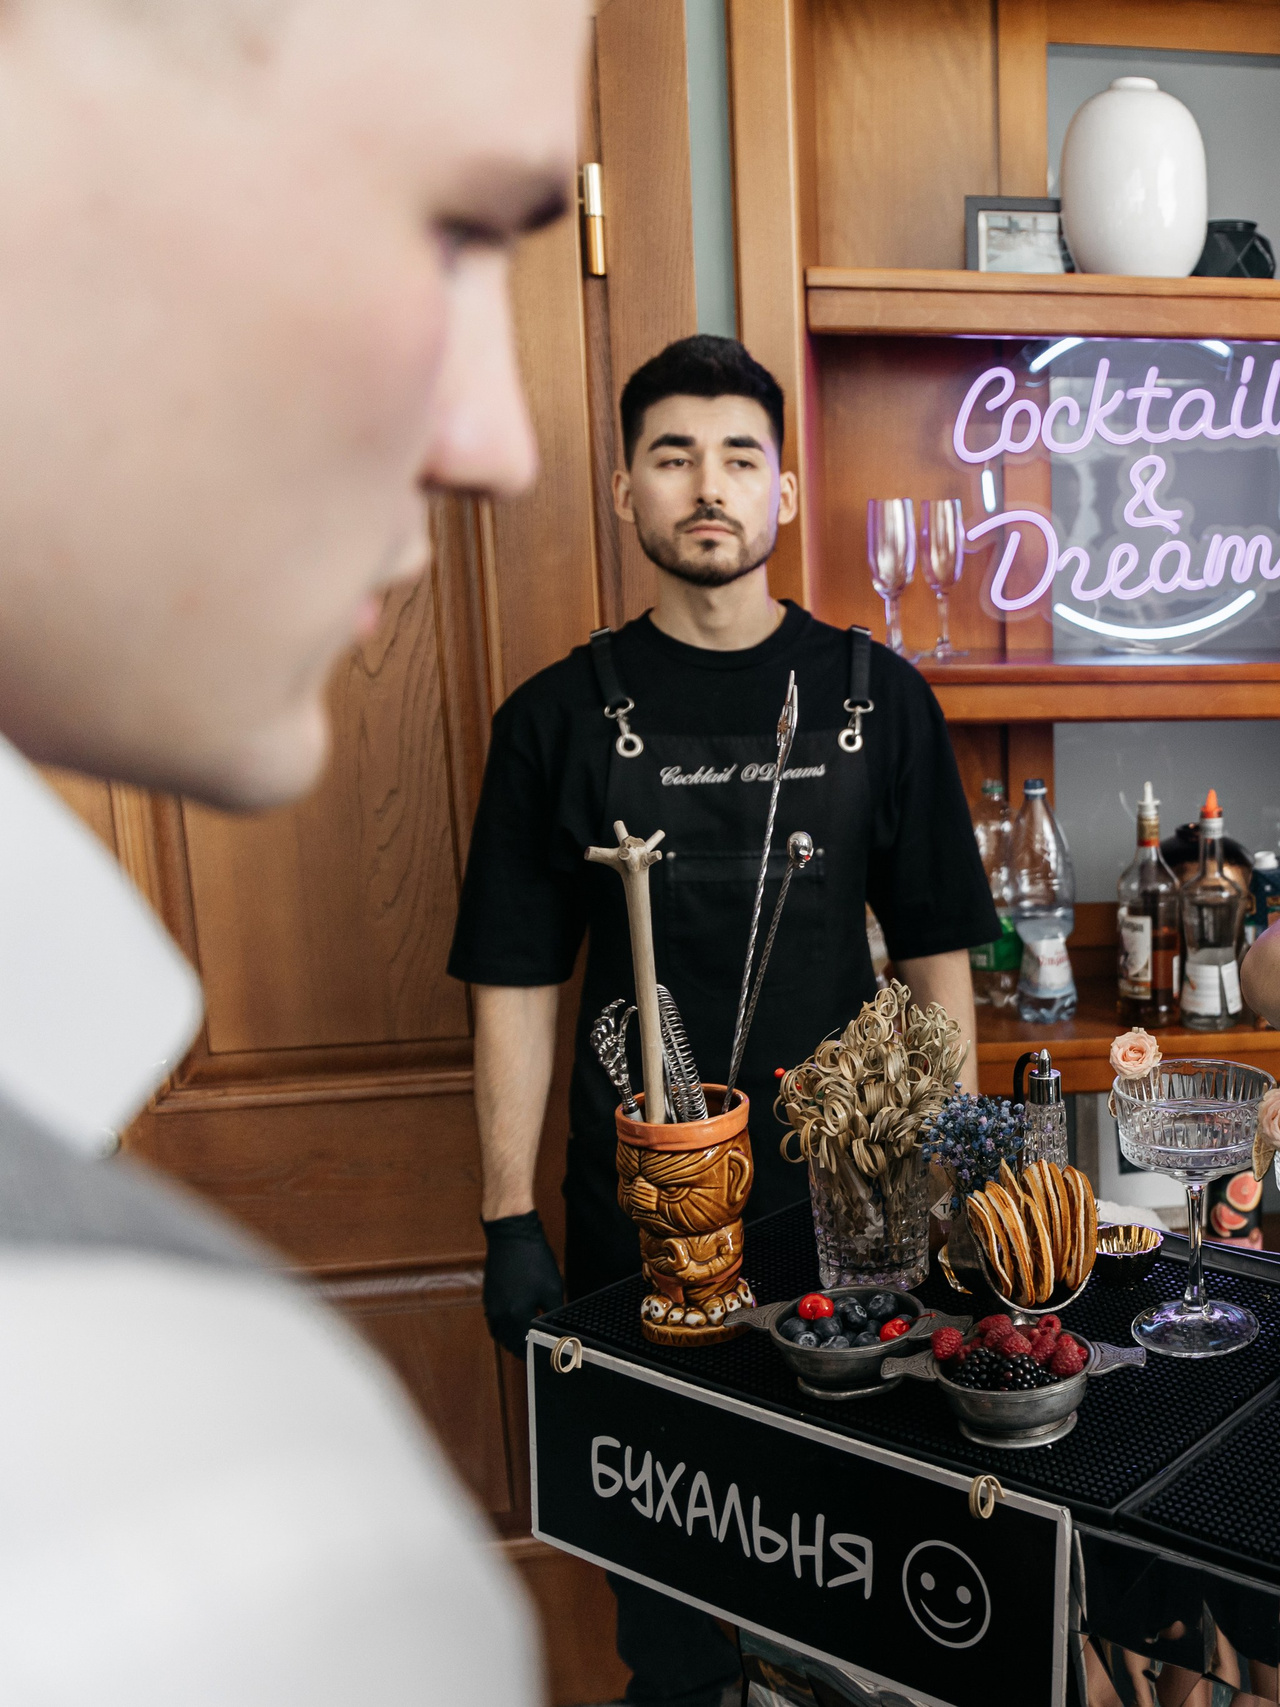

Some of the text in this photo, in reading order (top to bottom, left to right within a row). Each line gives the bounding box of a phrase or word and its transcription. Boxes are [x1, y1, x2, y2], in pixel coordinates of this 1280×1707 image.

[1124, 455, 1182, 534] &
[660, 763, 826, 786] Cocktail @Deams
[590, 1435, 874, 1599] БУХАЛЬНЯ
